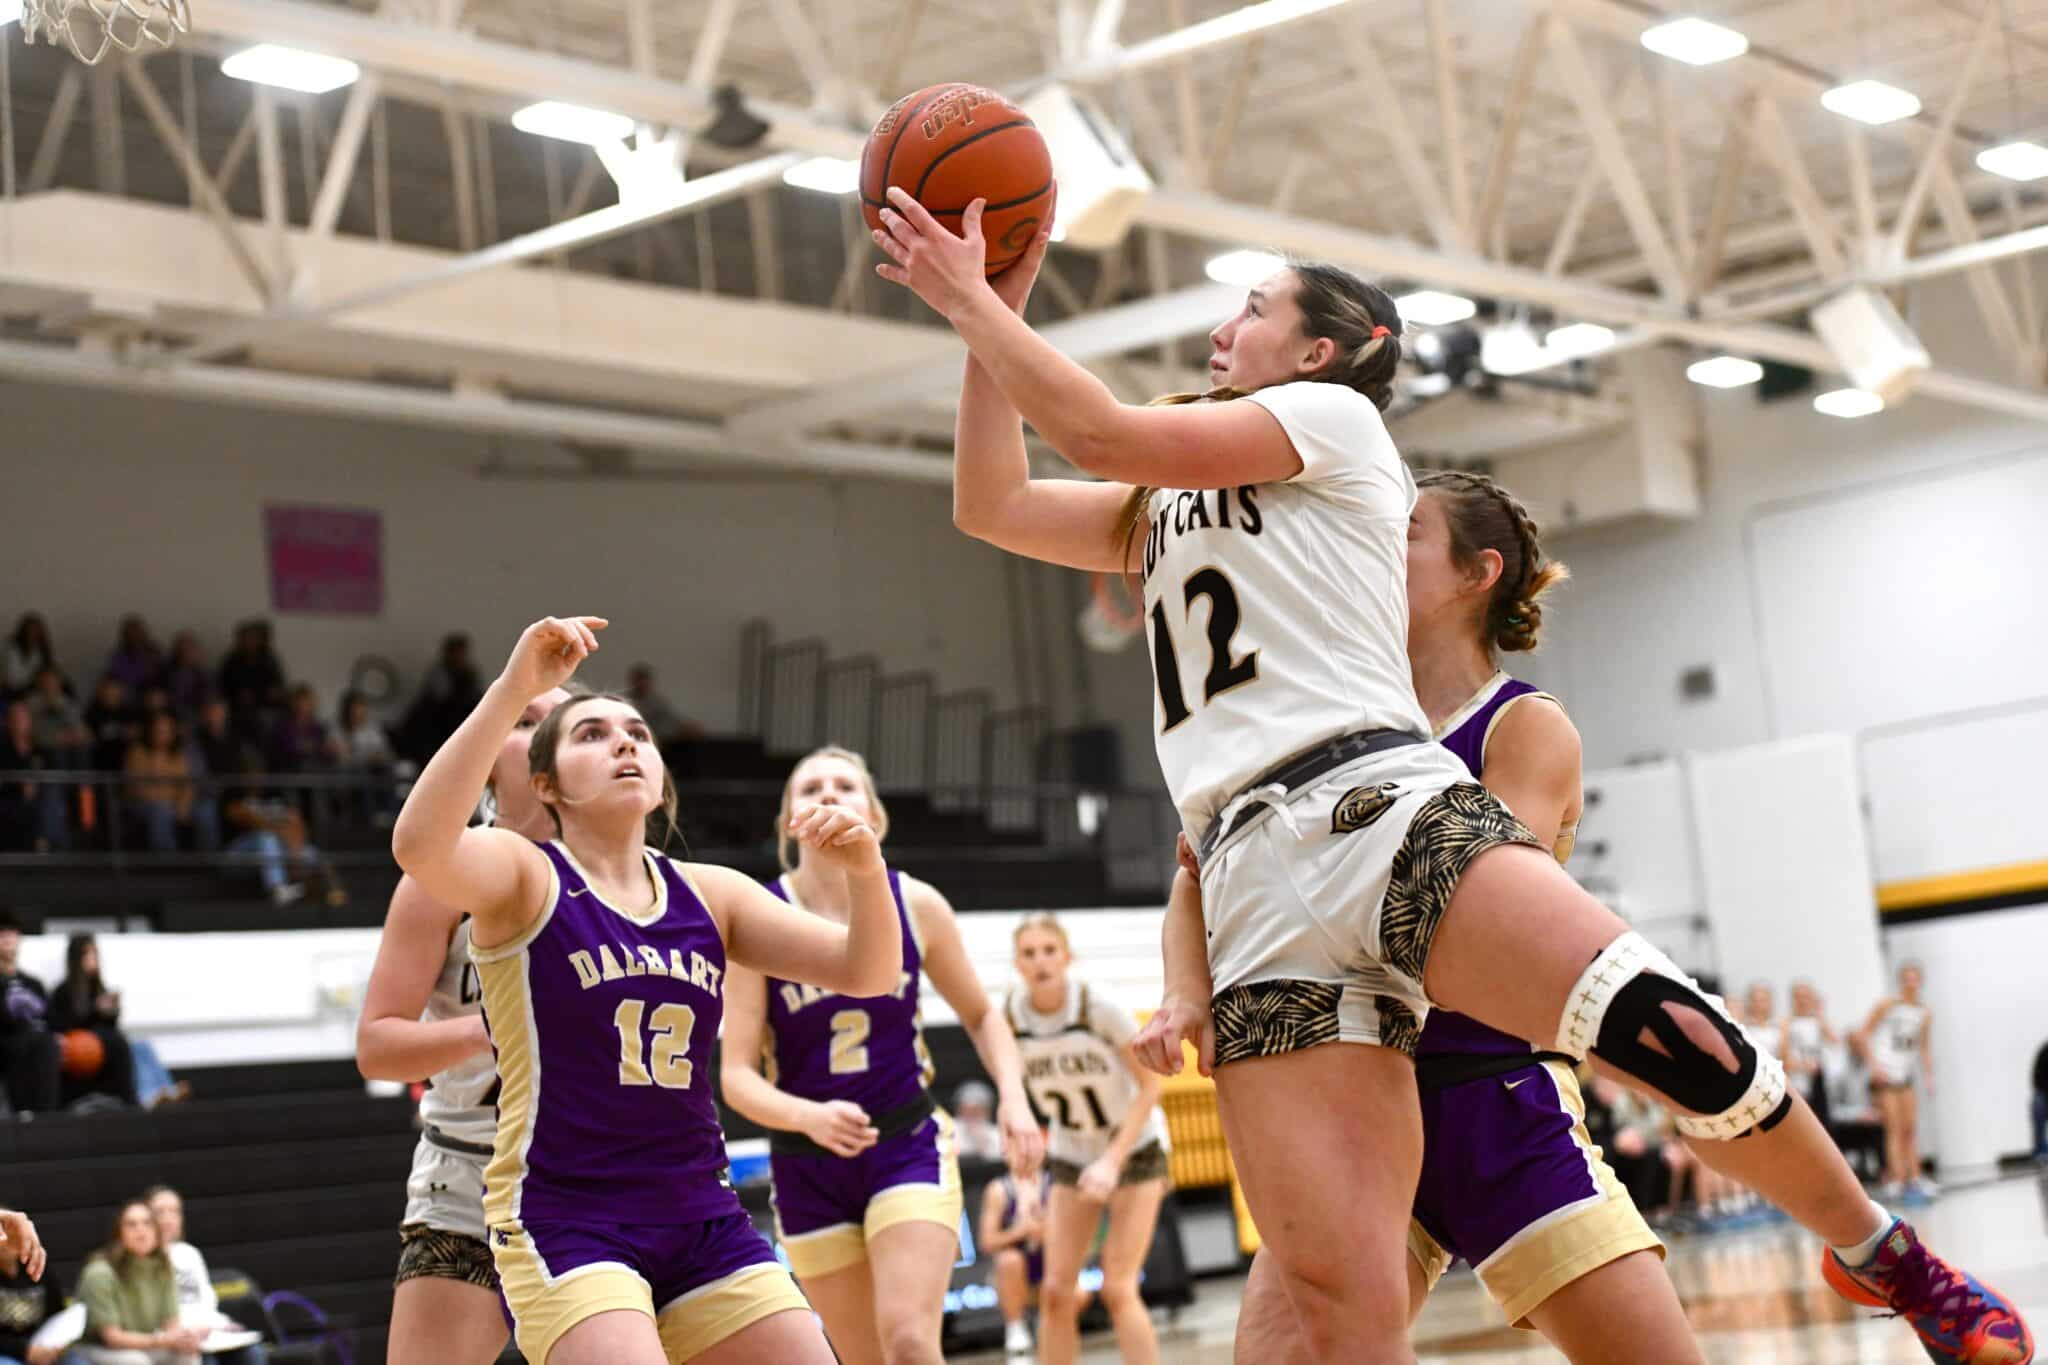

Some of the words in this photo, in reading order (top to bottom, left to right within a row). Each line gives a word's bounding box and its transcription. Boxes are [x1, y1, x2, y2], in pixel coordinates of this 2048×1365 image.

[1143, 503, 1172, 585] DY
[1151, 565, 1261, 735] 12
[568, 942, 722, 998] DALHART
[614, 999, 696, 1090] 12
[829, 1008, 872, 1075] 2
[1043, 1085, 1110, 1129] 21
